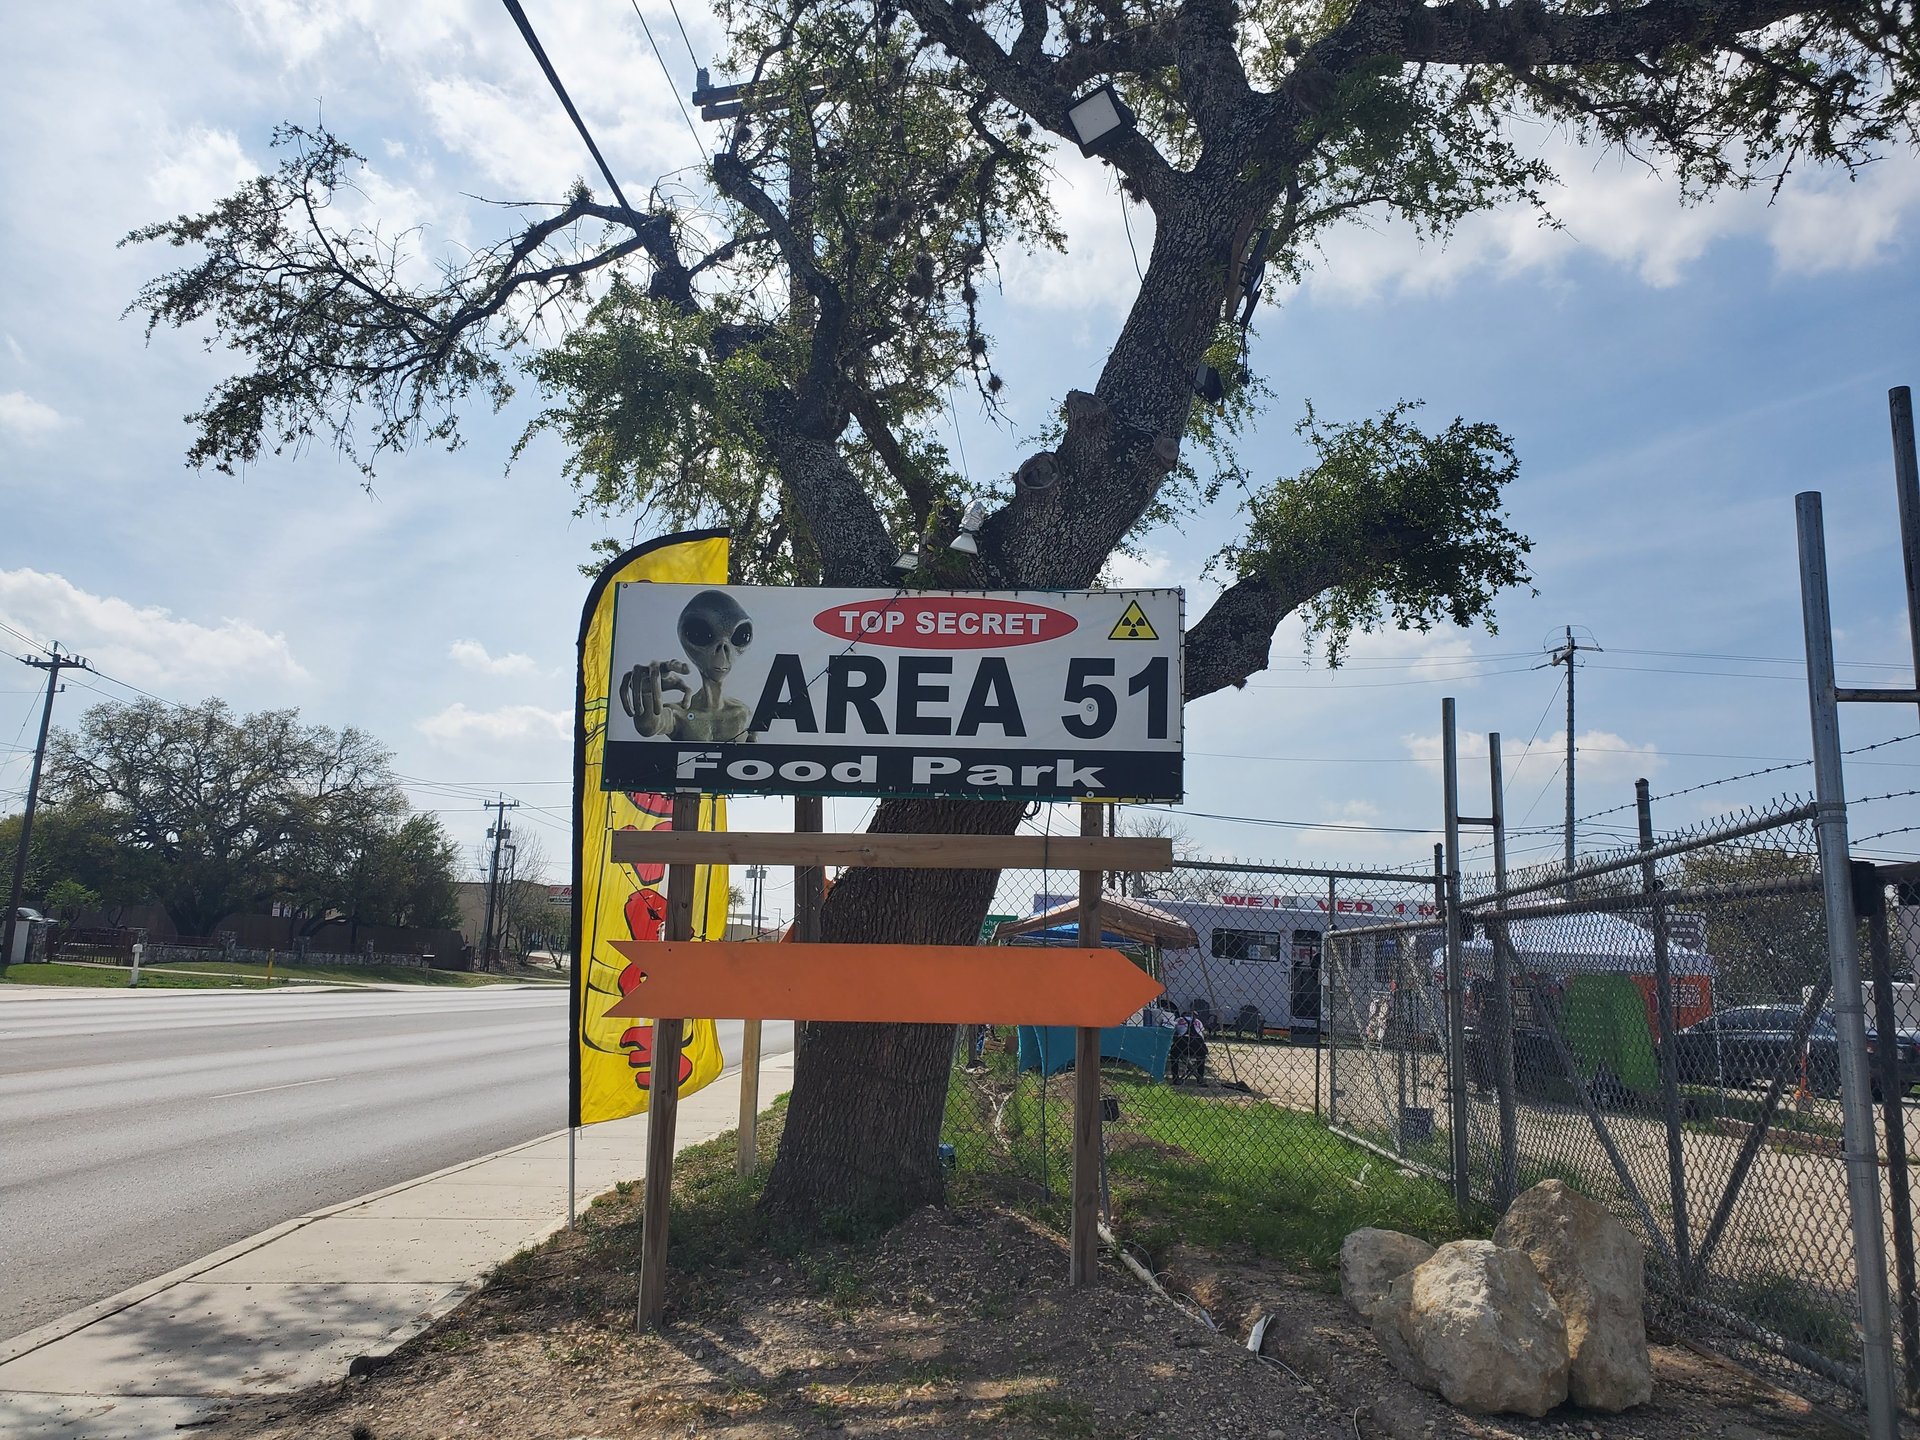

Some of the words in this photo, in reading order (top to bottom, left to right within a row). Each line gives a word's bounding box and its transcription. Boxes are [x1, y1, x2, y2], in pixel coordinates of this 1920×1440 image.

[839, 610, 904, 634] TOP
[915, 611, 1047, 635] SECRET
[748, 653, 1028, 738] AREA
[1060, 656, 1169, 740] 51
[675, 751, 878, 784] Food
[911, 756, 1106, 788] Park
